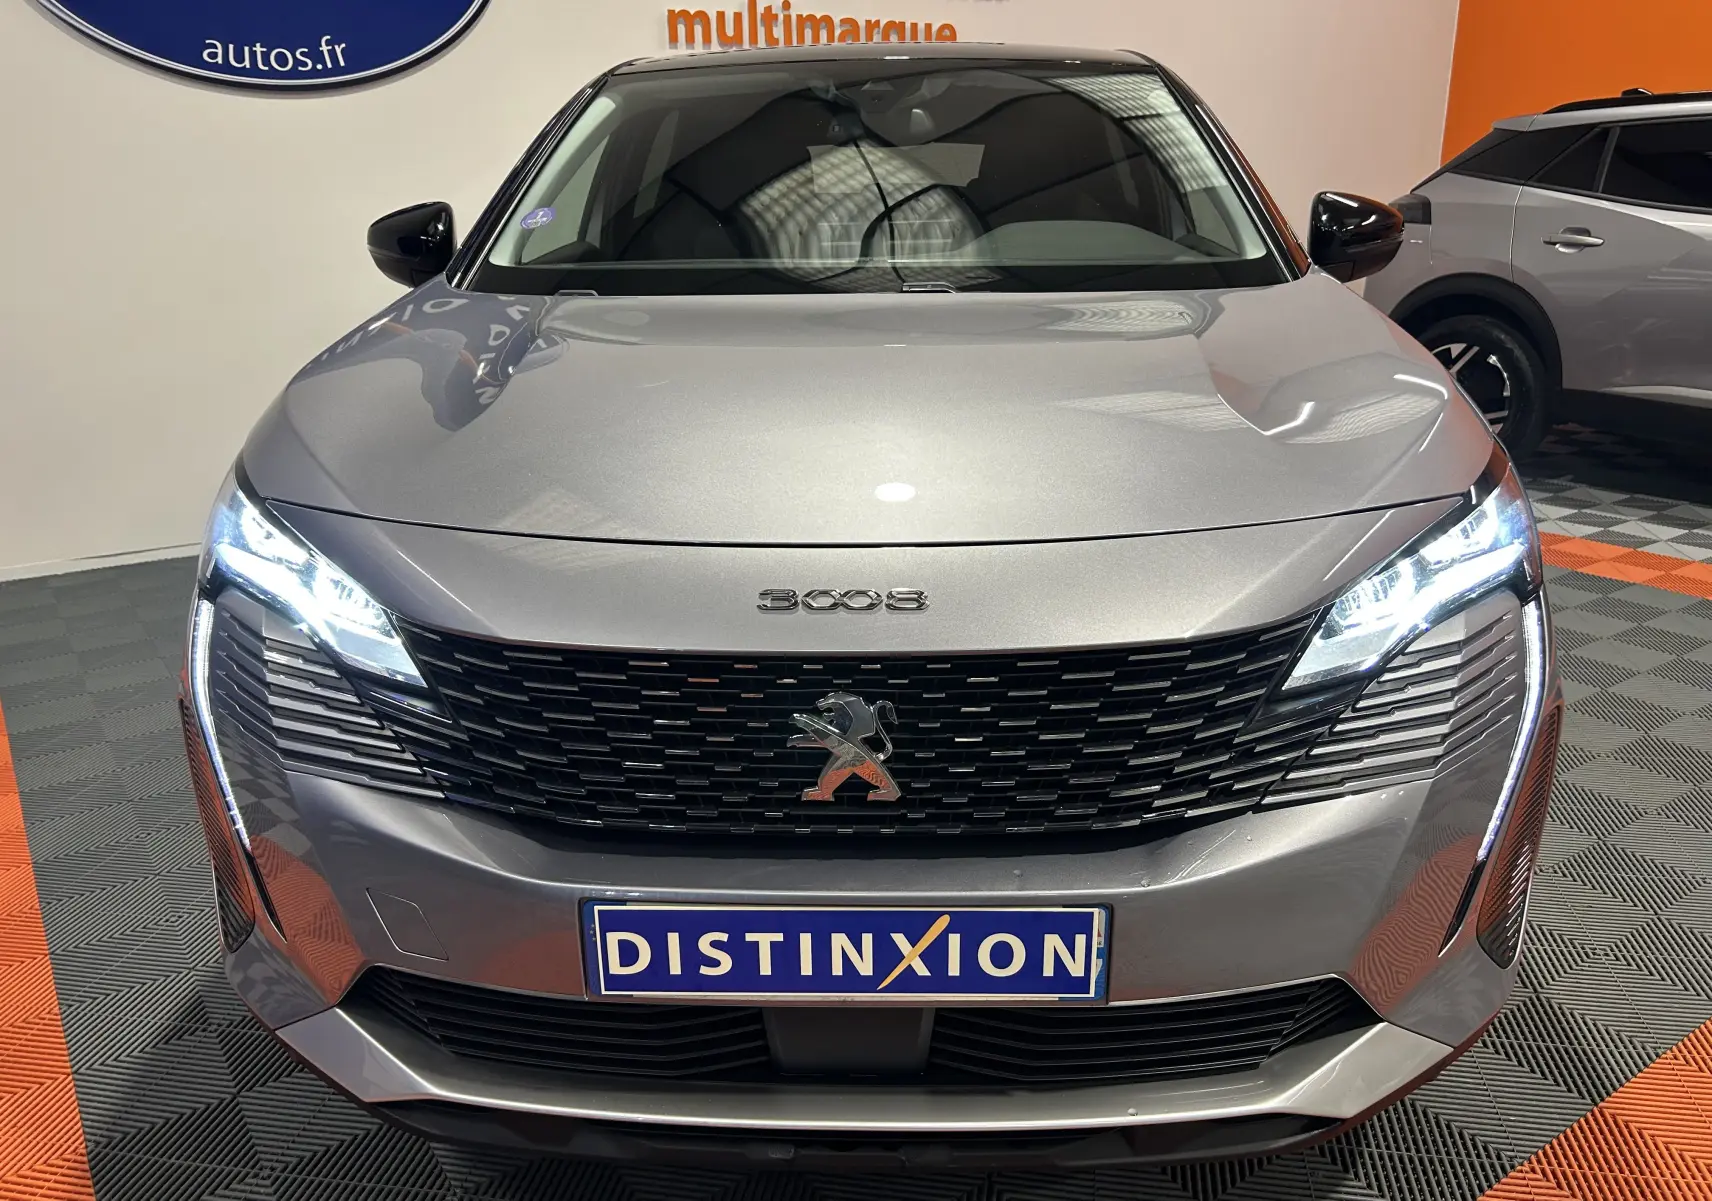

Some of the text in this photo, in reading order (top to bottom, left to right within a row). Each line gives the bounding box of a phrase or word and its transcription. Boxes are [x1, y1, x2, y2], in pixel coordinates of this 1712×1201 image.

[202, 35, 346, 71] autos.fr
[756, 587, 930, 613] 3008
[605, 914, 1087, 990] DISTINXION
